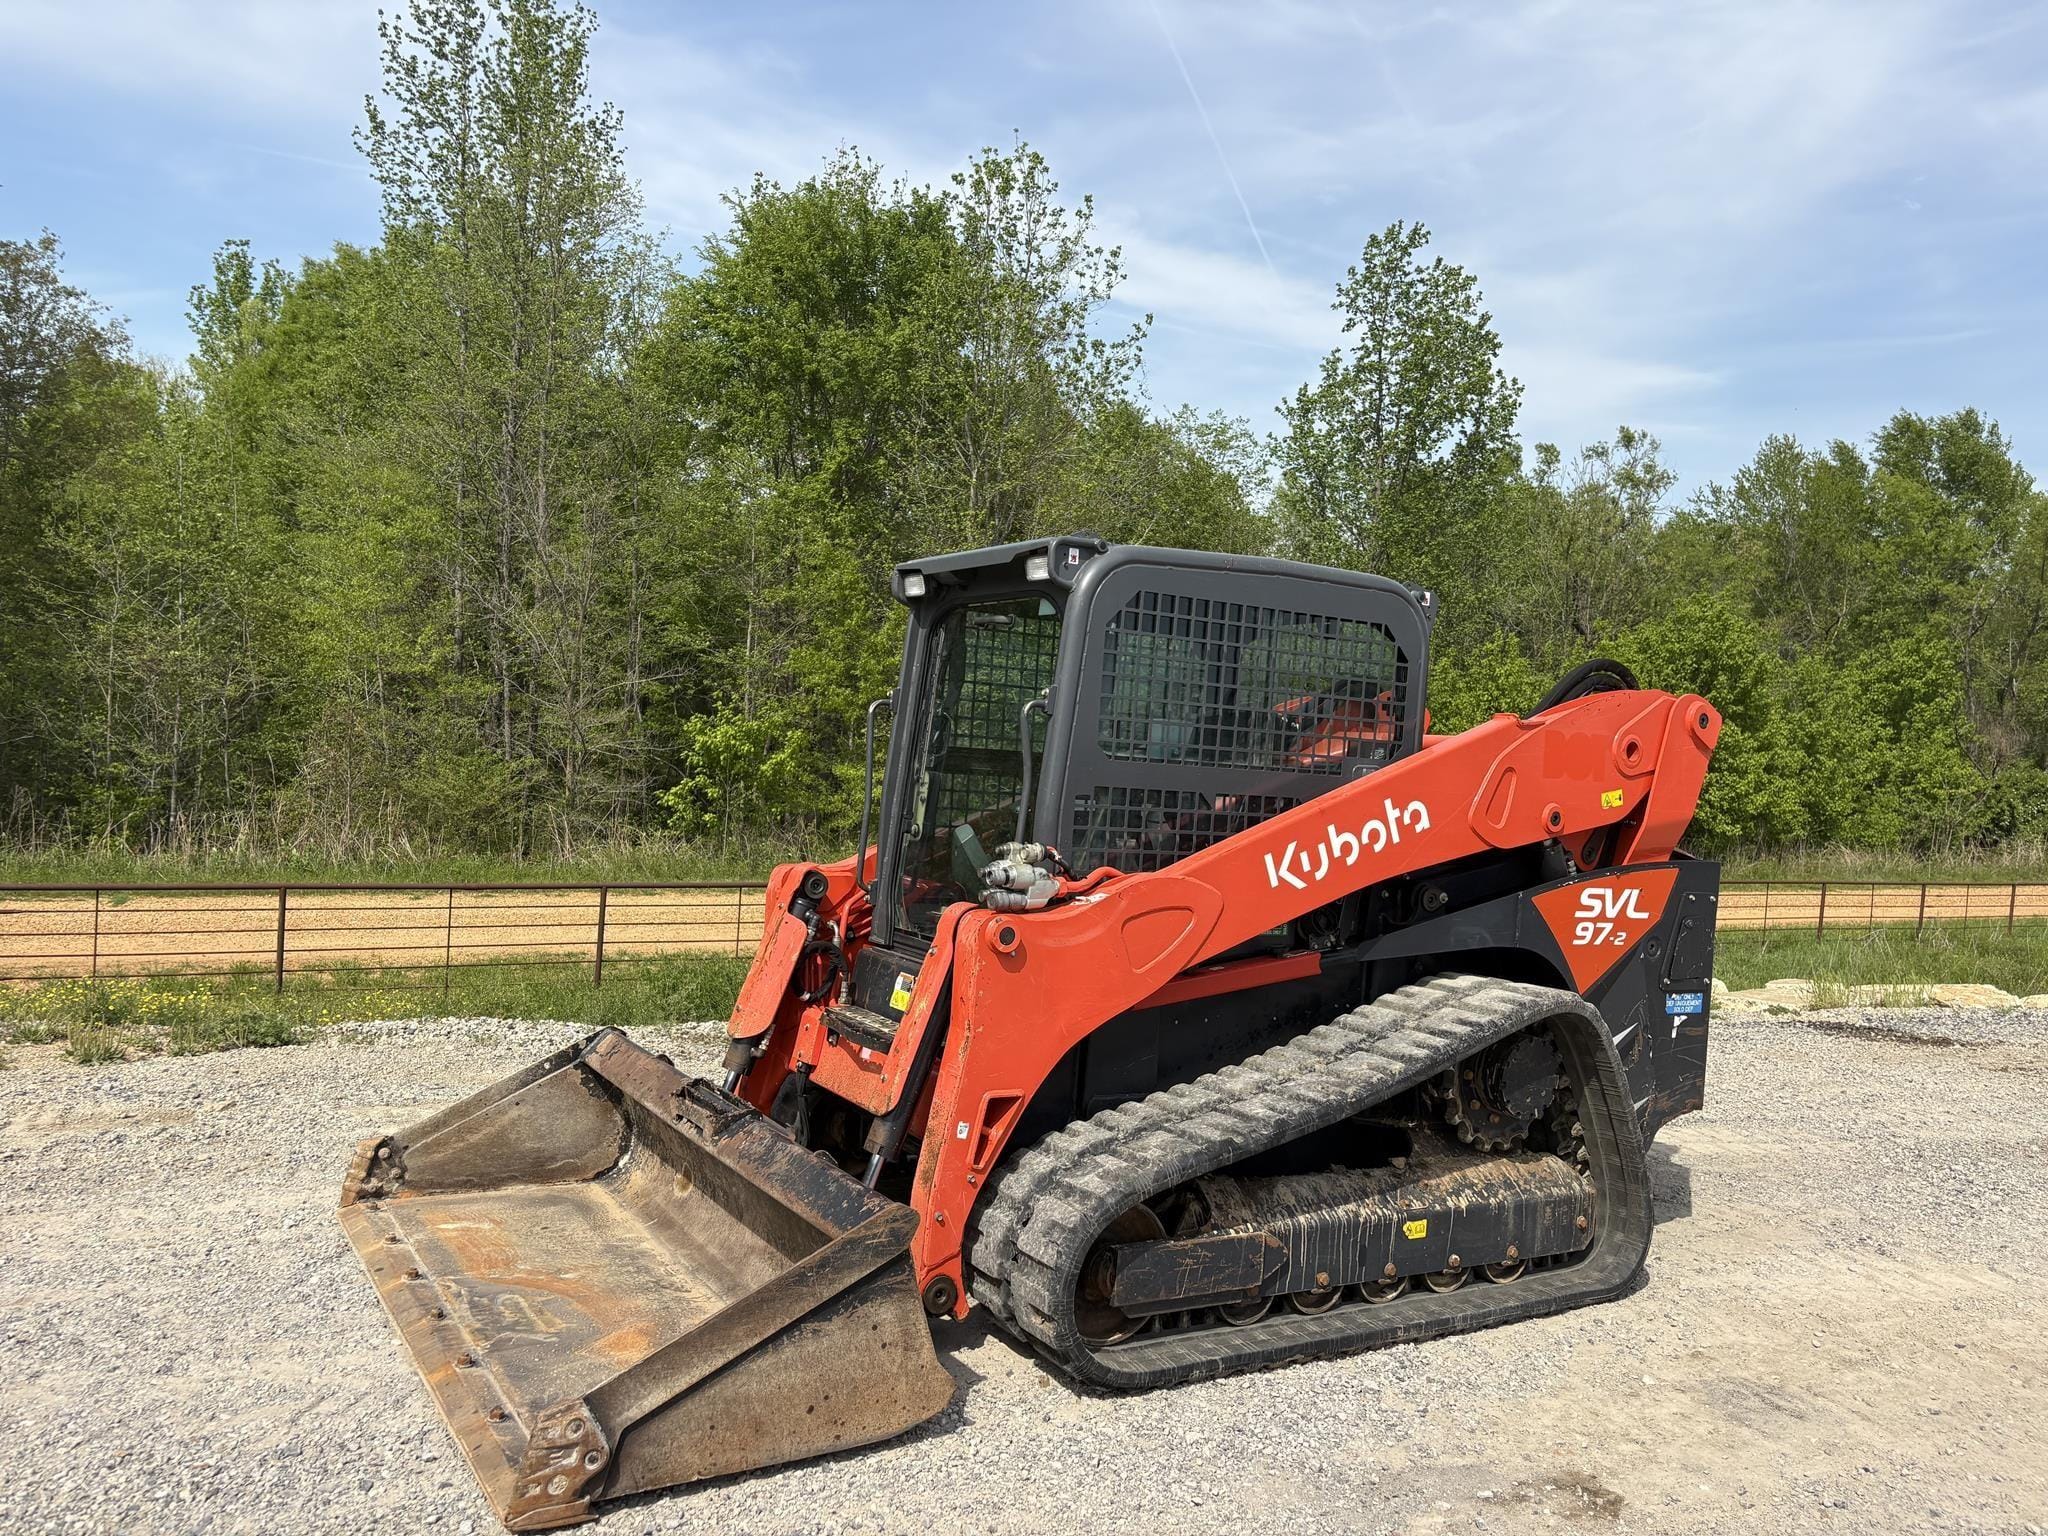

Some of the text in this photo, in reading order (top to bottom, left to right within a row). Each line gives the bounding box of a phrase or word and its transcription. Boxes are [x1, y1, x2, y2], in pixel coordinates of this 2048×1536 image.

[1264, 797, 1431, 890] Kubota
[1575, 888, 1650, 919] SVL
[1573, 922, 1627, 945] 97-2
